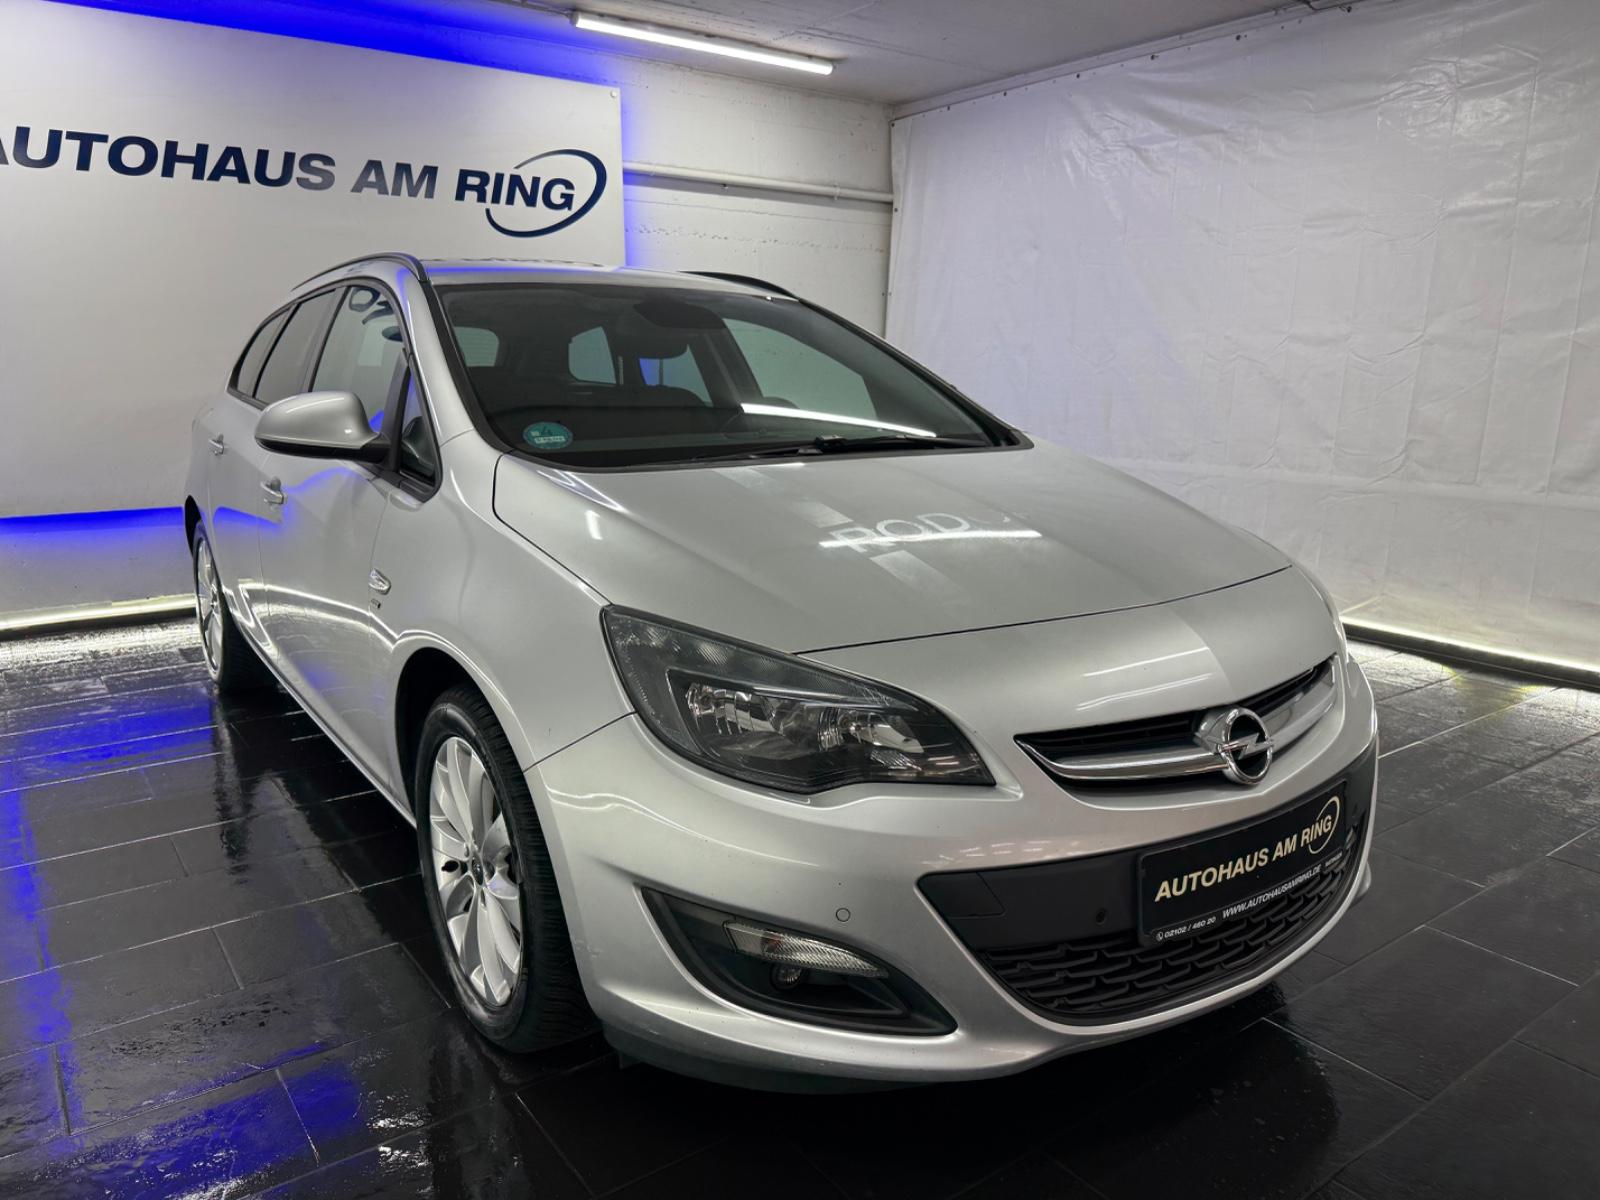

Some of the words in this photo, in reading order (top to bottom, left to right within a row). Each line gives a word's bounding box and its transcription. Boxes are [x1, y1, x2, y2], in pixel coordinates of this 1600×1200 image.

[0, 126, 336, 191] UTOHAUS
[350, 159, 439, 199] AM
[454, 167, 576, 212] RING
[1154, 848, 1269, 902] AUTOHAUS
[1272, 834, 1297, 862] AM
[1300, 814, 1332, 848] RING
